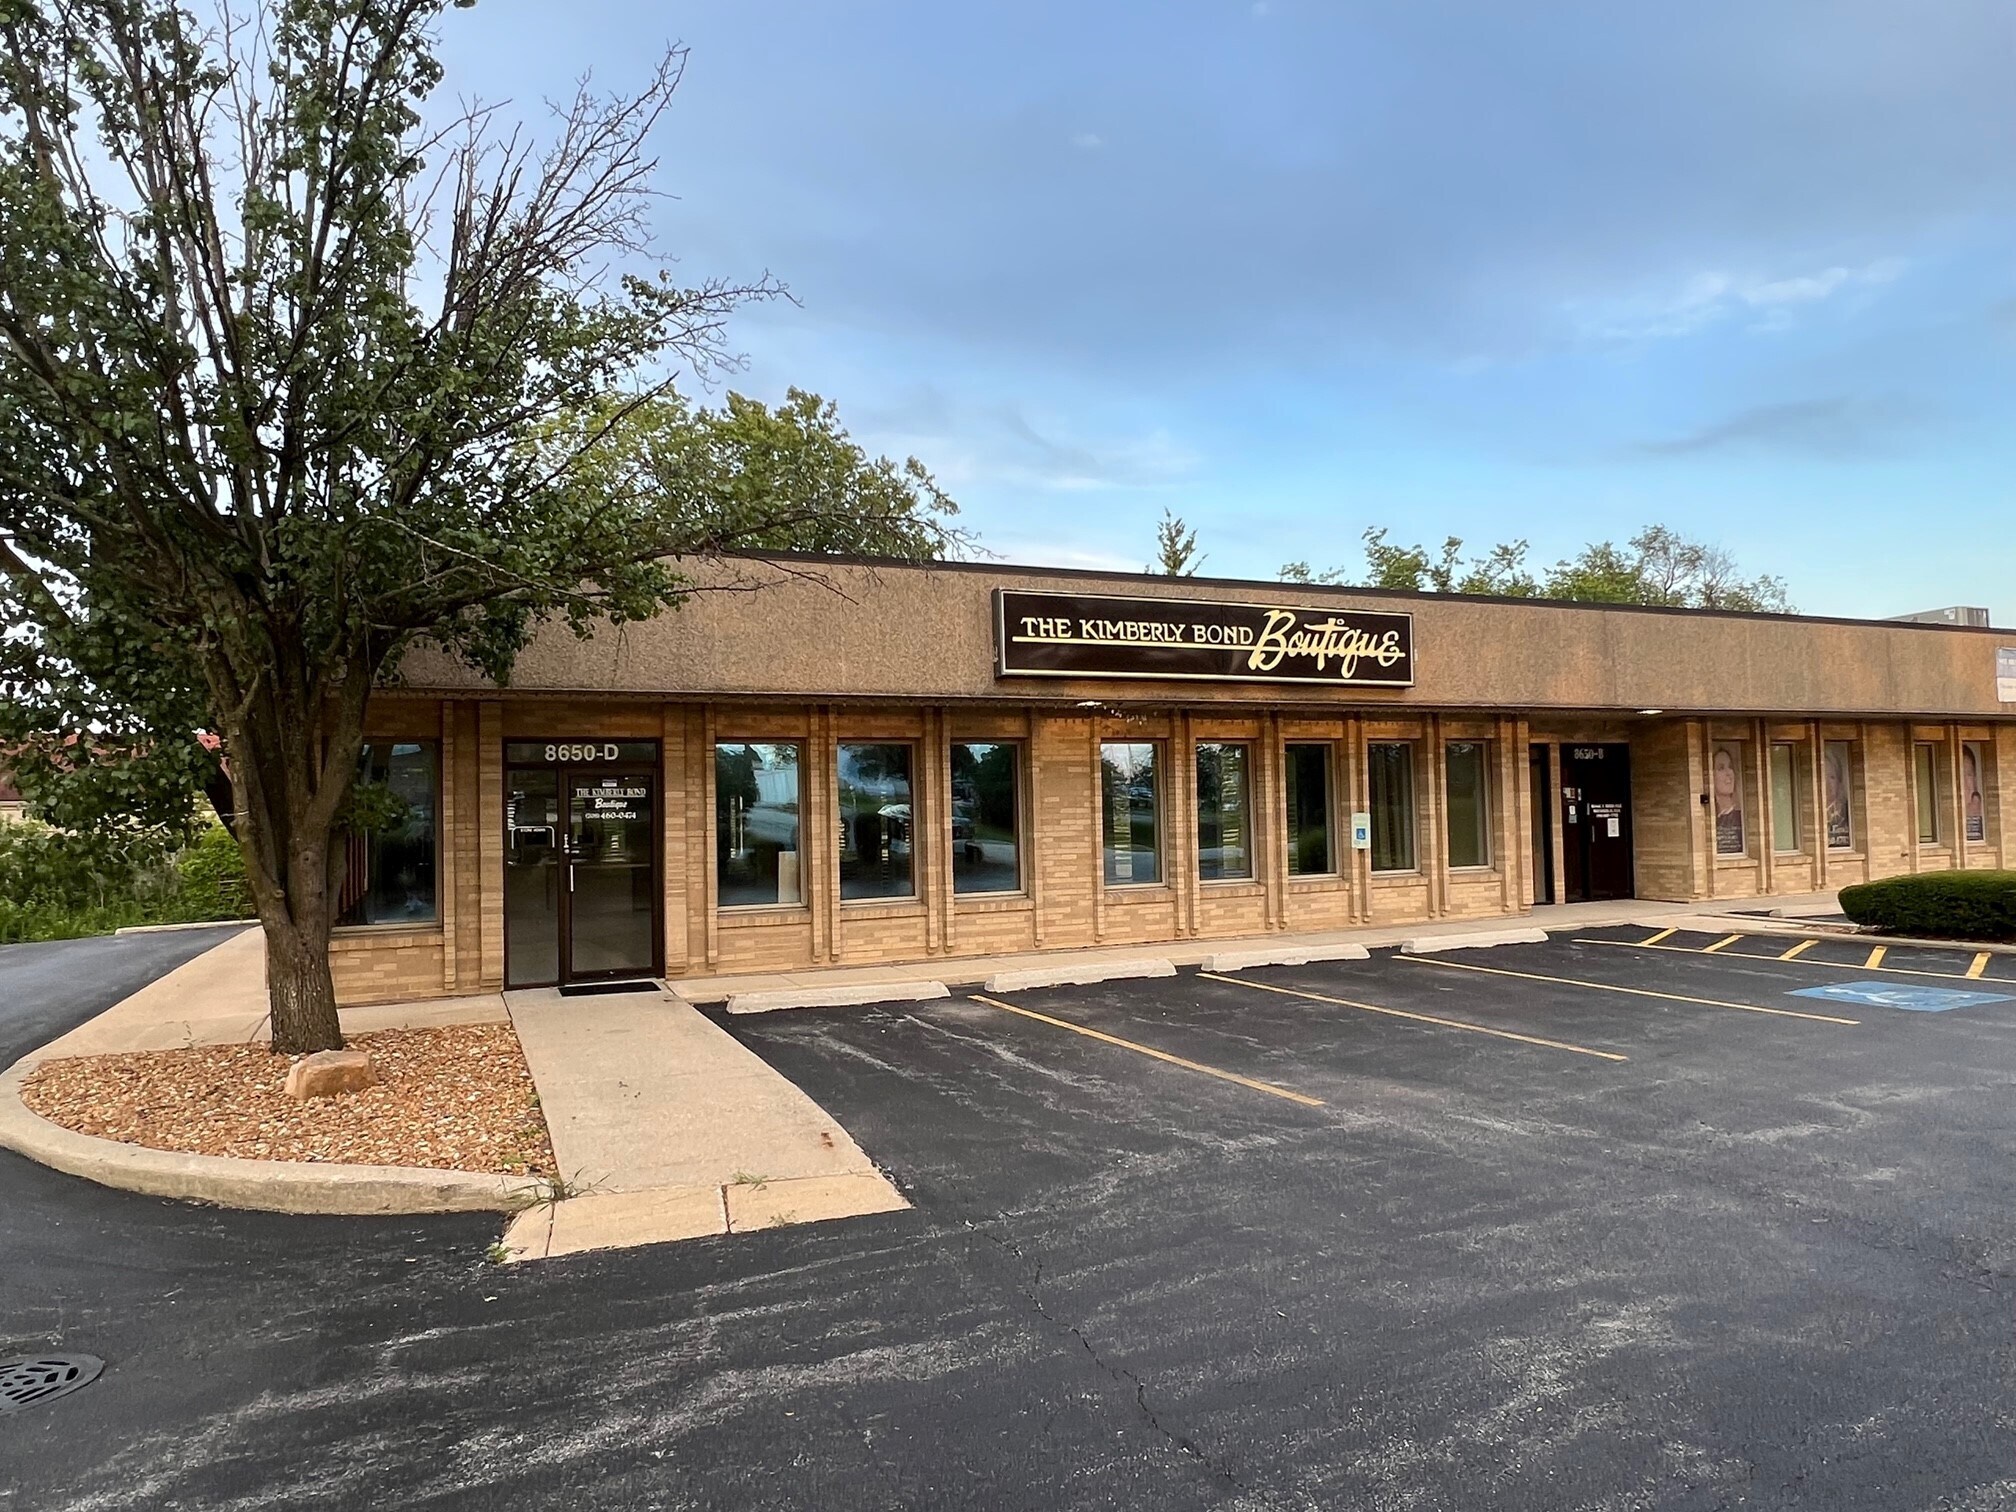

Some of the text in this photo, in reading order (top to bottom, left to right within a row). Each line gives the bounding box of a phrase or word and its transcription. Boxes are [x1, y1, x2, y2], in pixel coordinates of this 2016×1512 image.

[1020, 609, 1400, 679] THE KIMBERLY BOND Boutique
[544, 743, 619, 761] 8650-D
[576, 788, 590, 797] THE
